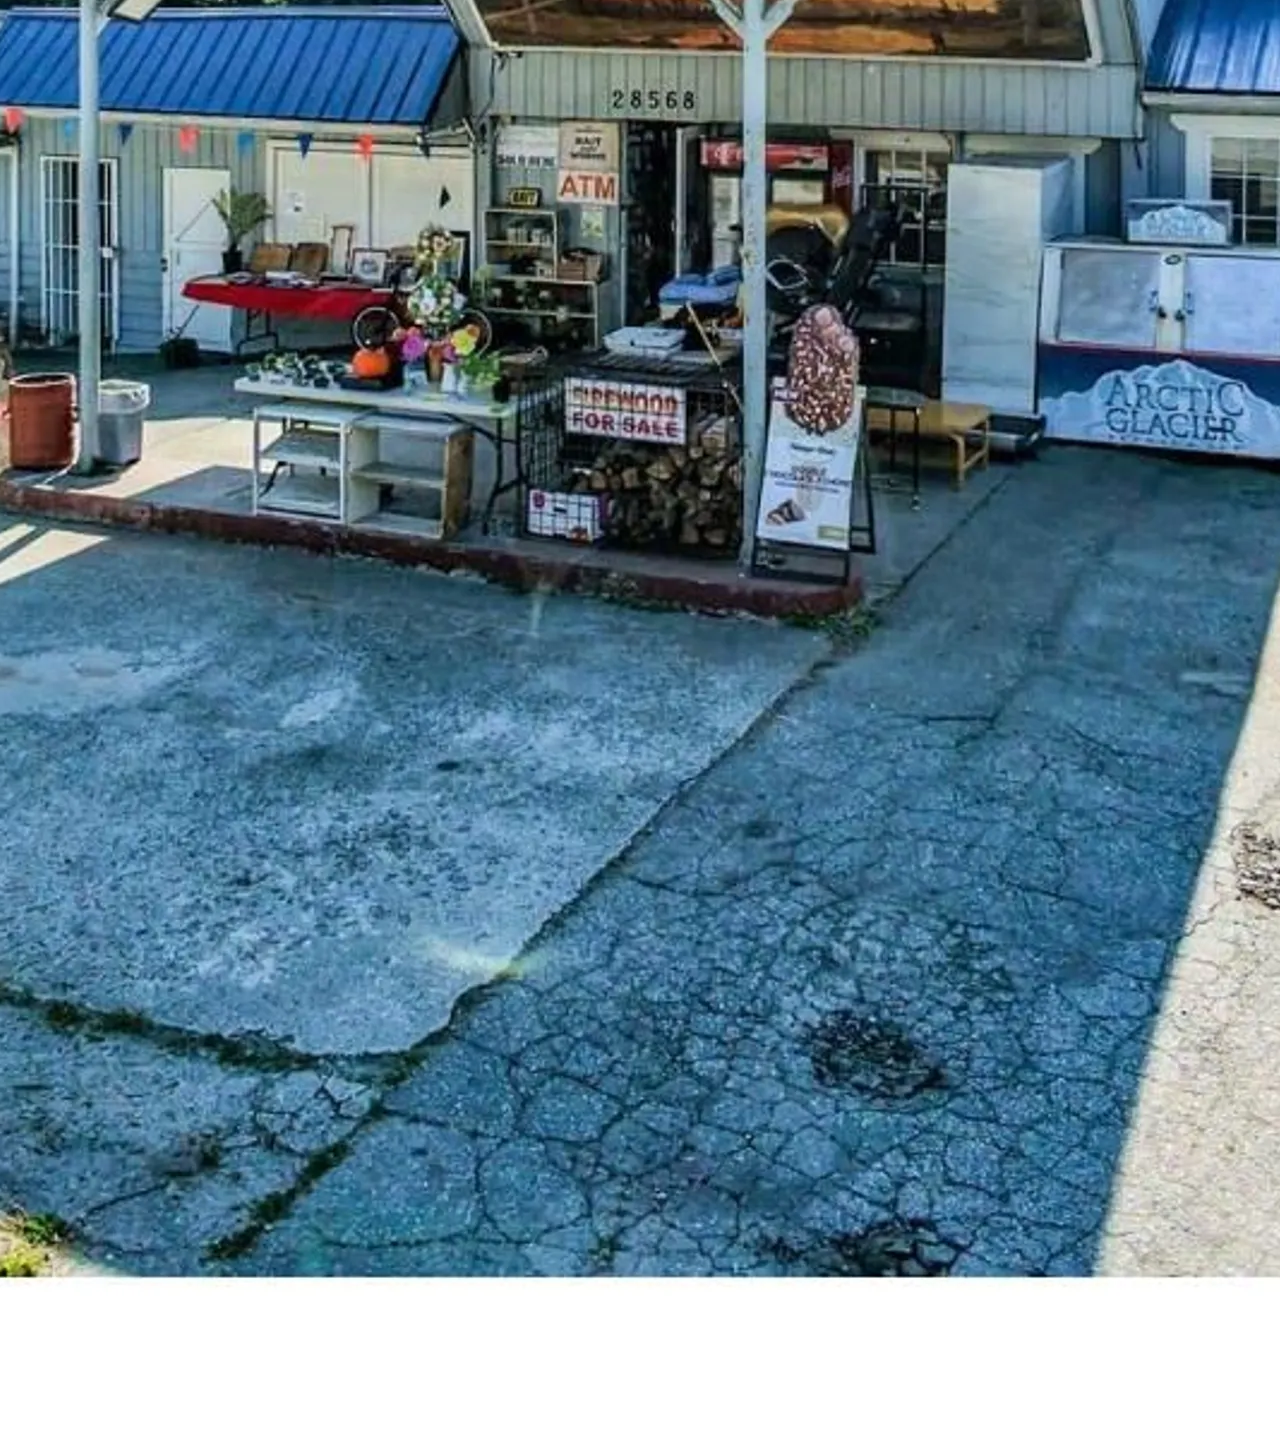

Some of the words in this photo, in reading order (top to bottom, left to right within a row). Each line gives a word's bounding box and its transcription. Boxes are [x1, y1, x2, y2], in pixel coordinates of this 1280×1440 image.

[612, 89, 695, 110] 28568
[559, 174, 616, 200] ATM
[1105, 374, 1244, 417] ARCTIC
[572, 413, 615, 431] FOR
[622, 416, 679, 438] SALE
[1105, 408, 1244, 442] GLACIER
